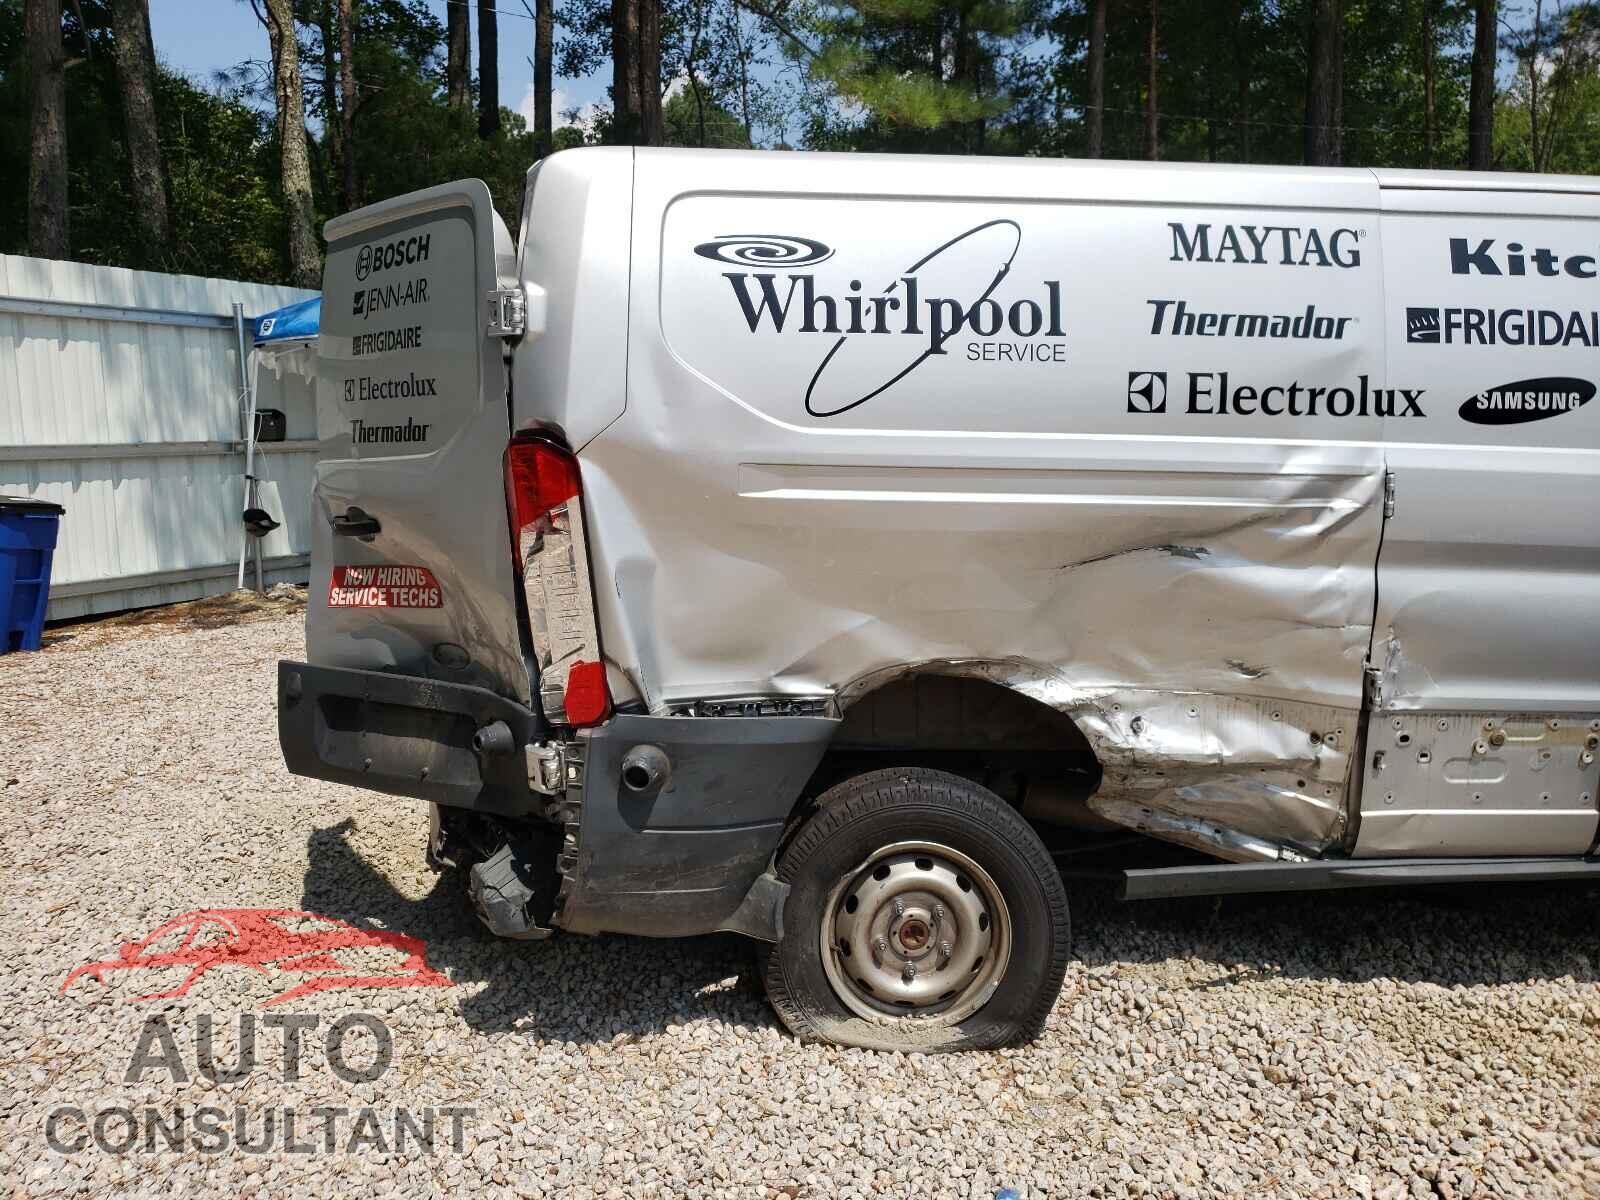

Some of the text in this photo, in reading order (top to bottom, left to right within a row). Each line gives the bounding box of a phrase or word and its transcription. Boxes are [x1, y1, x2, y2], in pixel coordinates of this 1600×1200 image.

[372, 234, 430, 273] BOSCH
[722, 273, 1067, 354] Whirlpool
[1146, 300, 1352, 340] Thermador
[361, 326, 422, 355] FRIGIDAIRE
[966, 342, 1067, 362] SERVICE
[359, 372, 437, 400] Electrolux
[1185, 372, 1426, 417] Electrolux
[1476, 390, 1580, 411] SAMSUNG
[350, 417, 429, 443] Thermador
[343, 567, 426, 586] NOW HIRING
[330, 587, 438, 607] SERVICE TECHS
